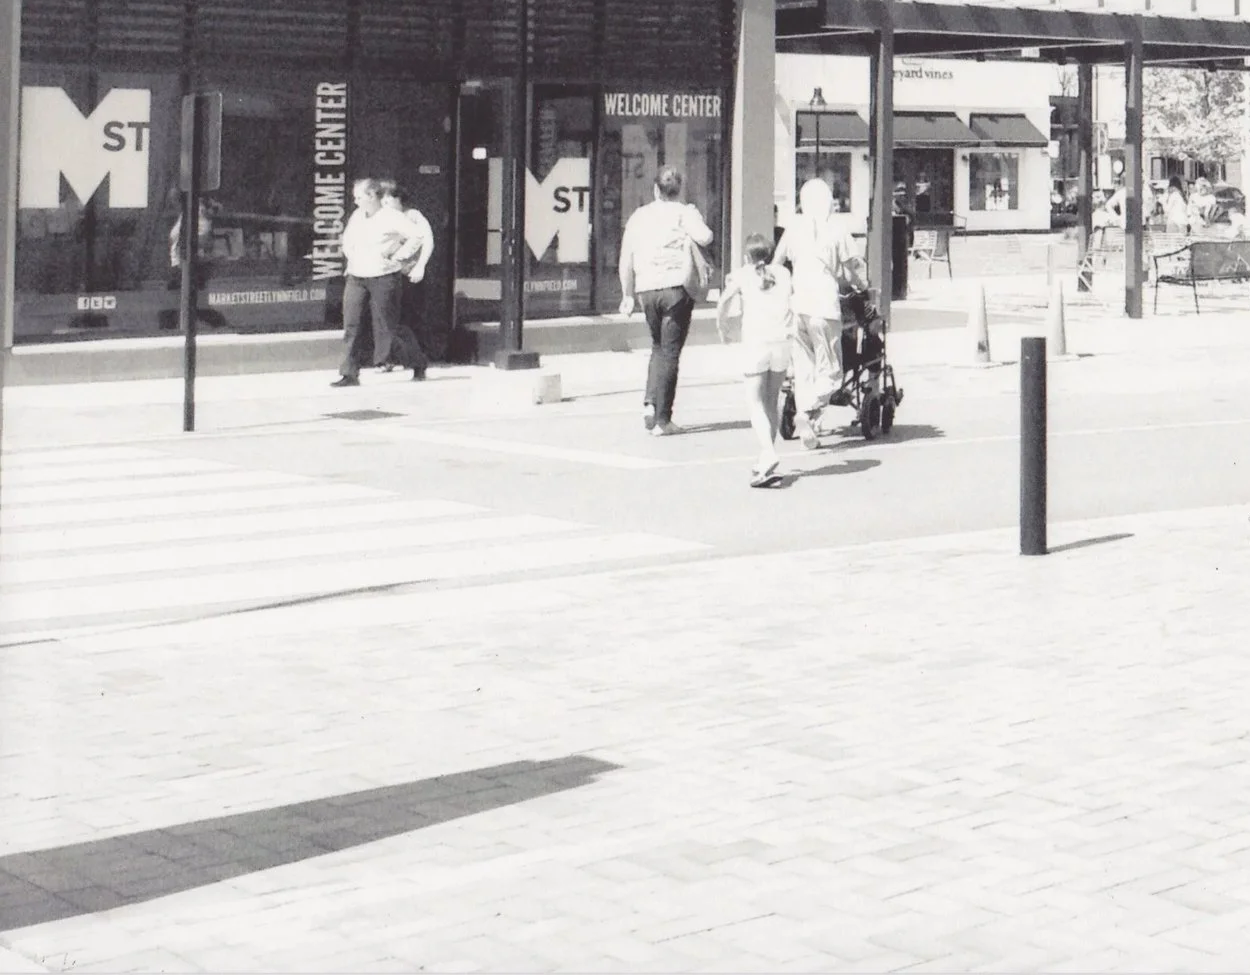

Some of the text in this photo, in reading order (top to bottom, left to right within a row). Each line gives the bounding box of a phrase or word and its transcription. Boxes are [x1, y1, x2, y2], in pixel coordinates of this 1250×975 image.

[924, 70, 954, 80] vines
[604, 92, 721, 118] WELCOME CENTER
[19, 86, 150, 209] M ST
[312, 81, 347, 281] WELCOME CENTER
[553, 186, 590, 213] ST
